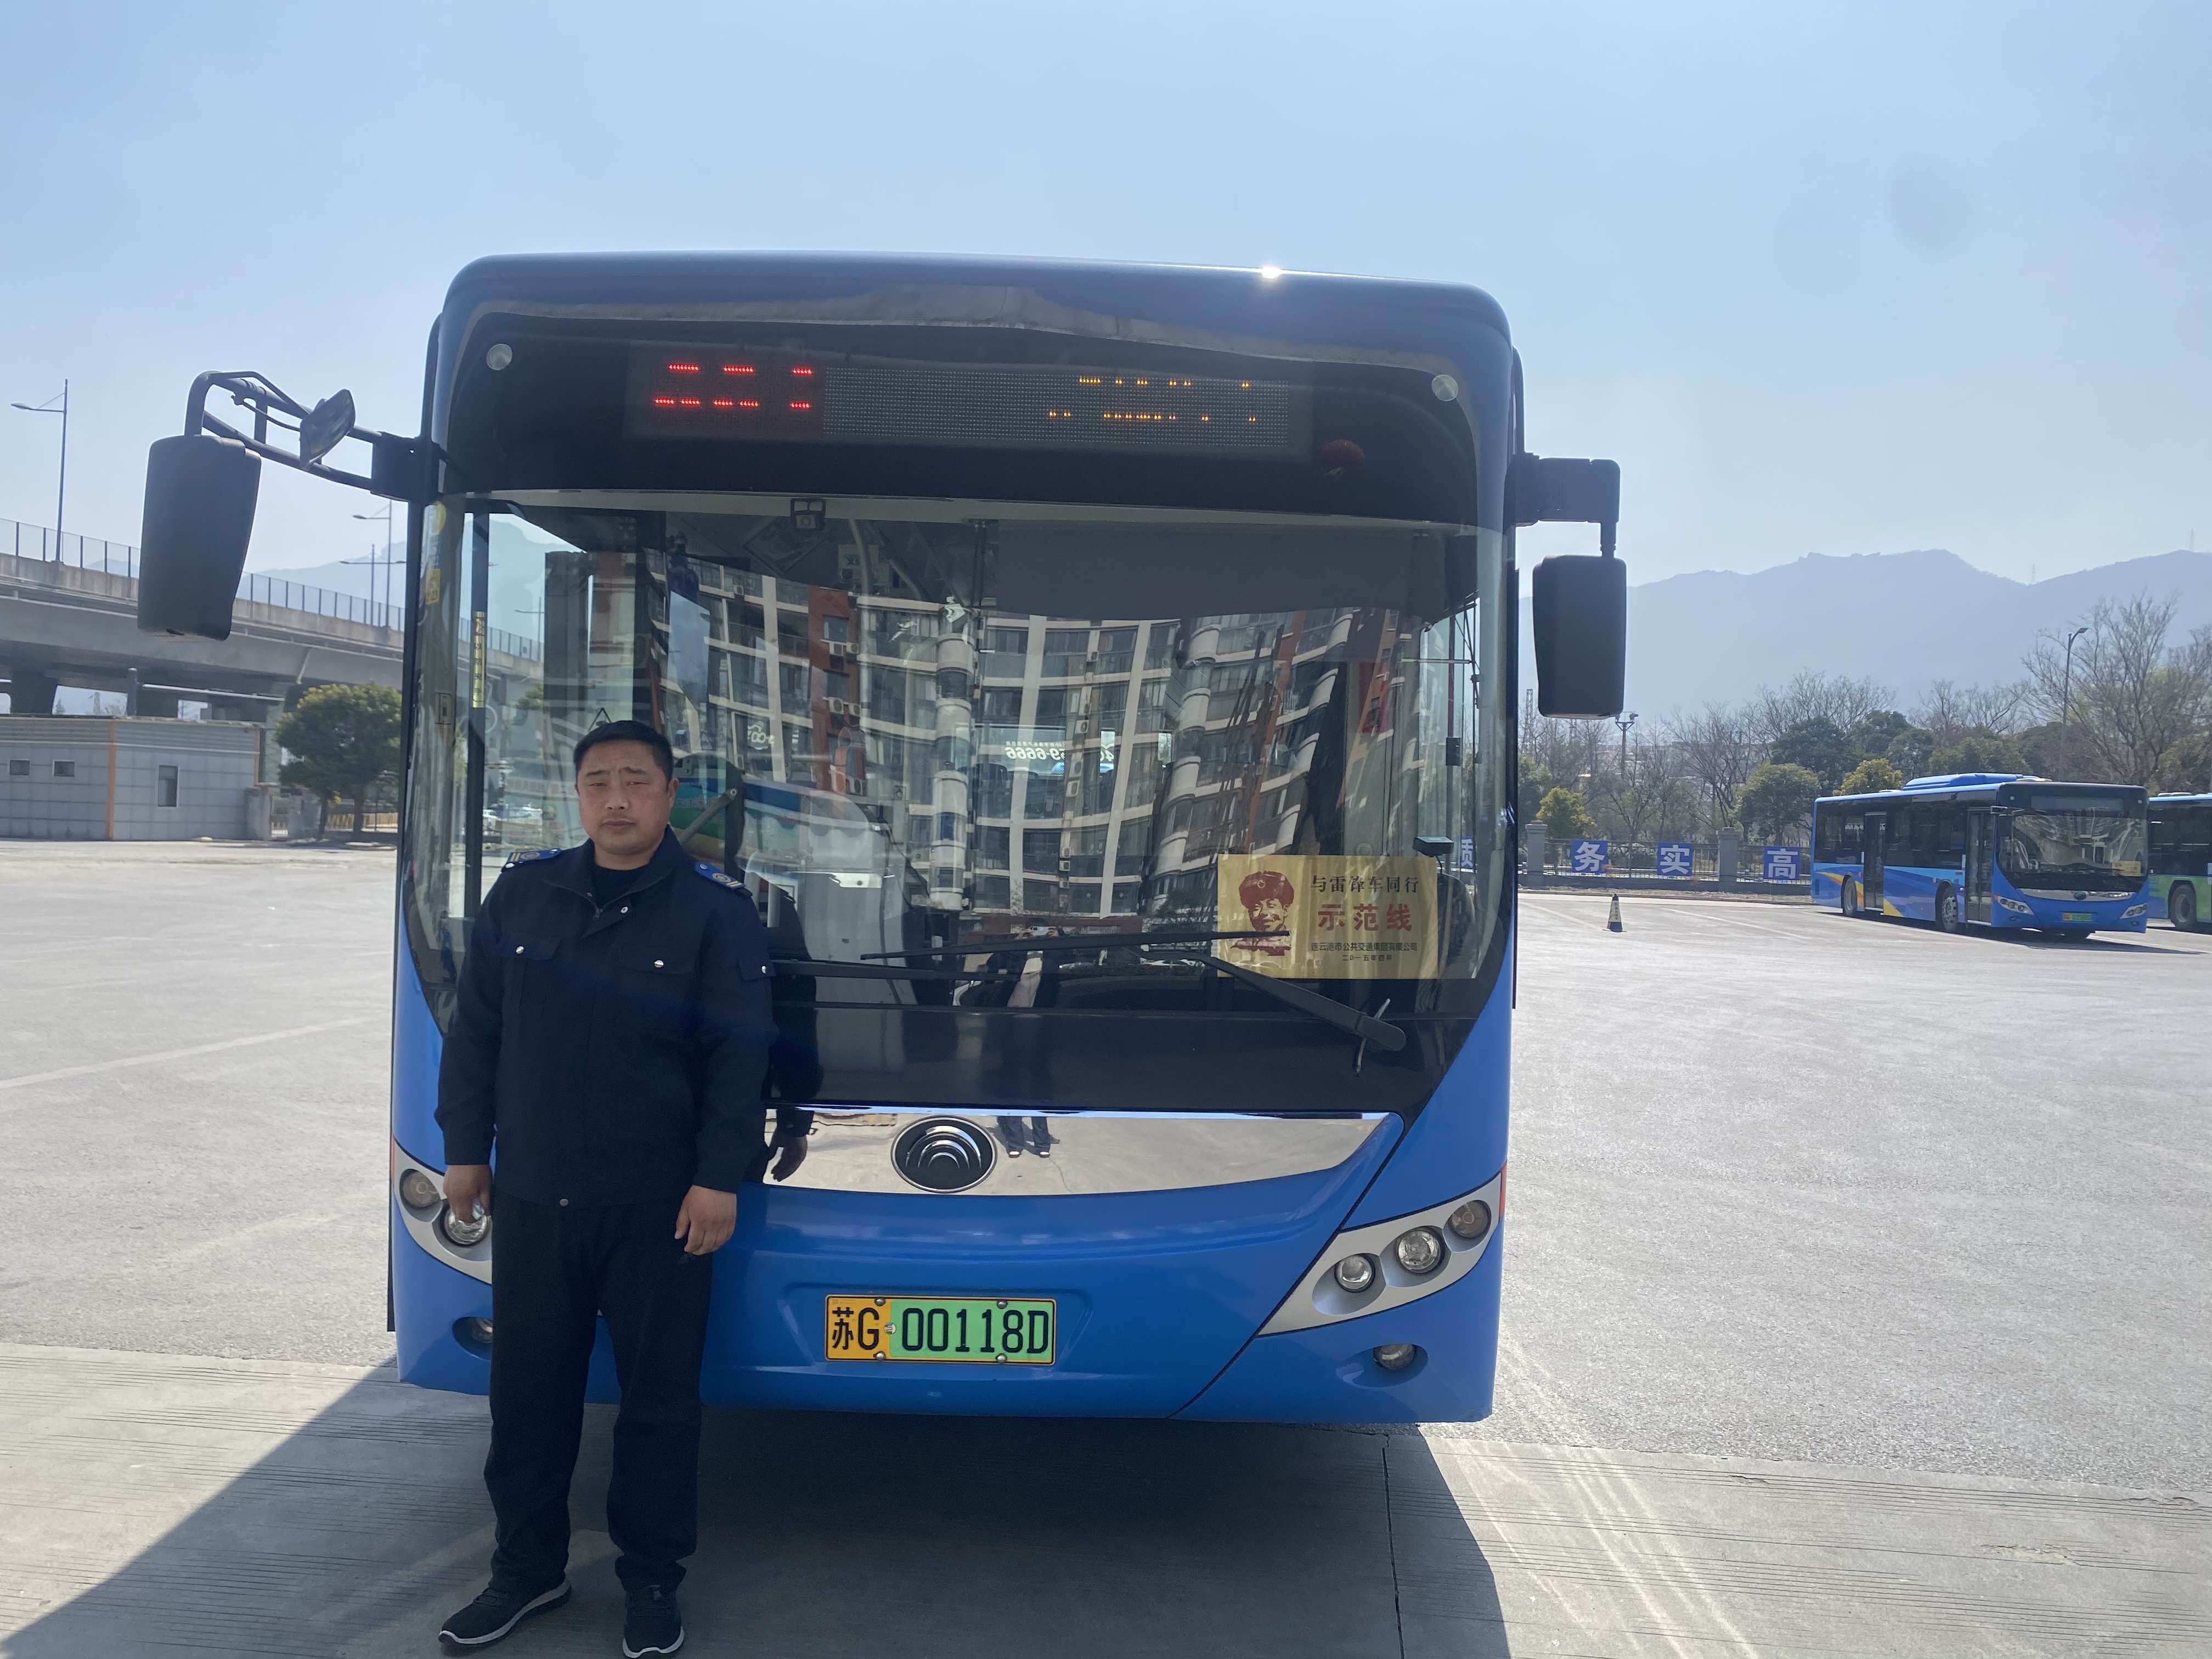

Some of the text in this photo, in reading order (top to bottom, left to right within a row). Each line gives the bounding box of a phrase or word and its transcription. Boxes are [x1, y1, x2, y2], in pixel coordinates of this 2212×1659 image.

[1574, 841, 1605, 873] 务
[1660, 844, 1690, 874] 实
[1767, 848, 1798, 879] 高
[1310, 875, 1419, 893] 与雷锋车同行
[1318, 904, 1412, 932] 示范线
